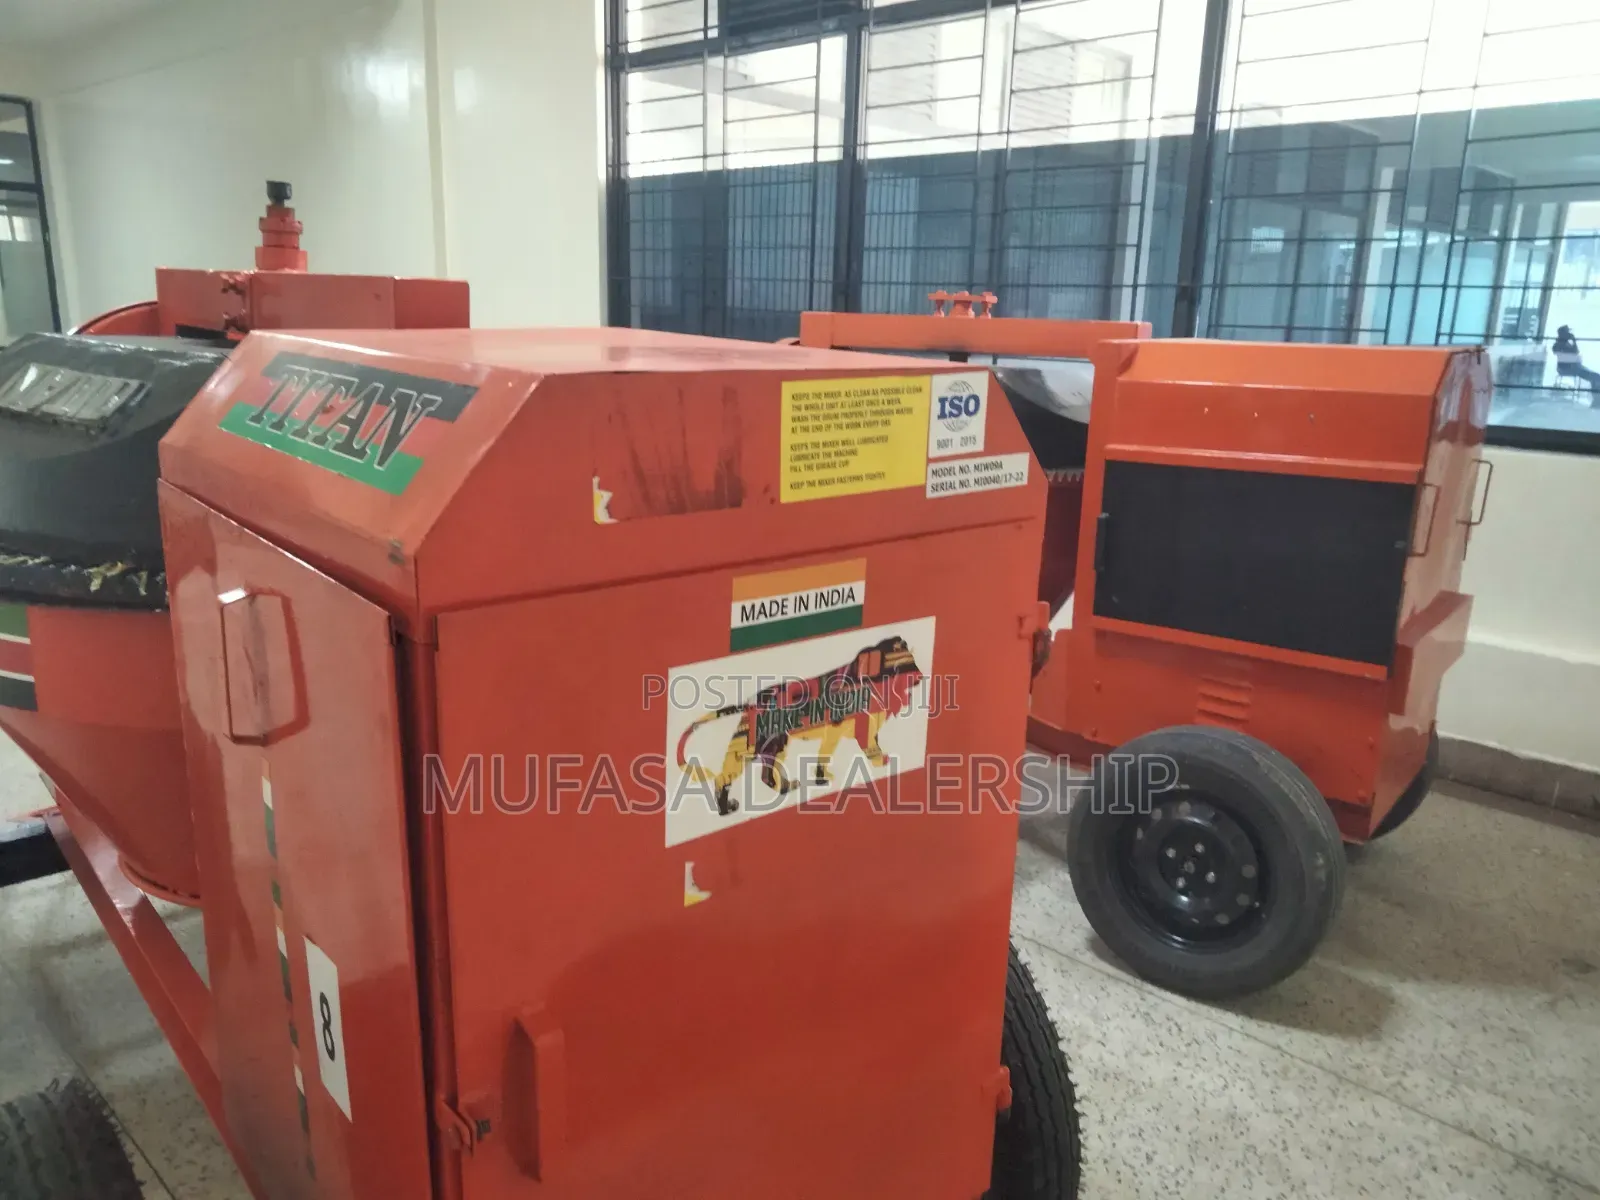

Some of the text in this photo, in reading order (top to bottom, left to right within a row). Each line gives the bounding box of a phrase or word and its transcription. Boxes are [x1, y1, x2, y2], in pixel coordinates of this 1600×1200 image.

[812, 391, 822, 400] THE
[824, 390, 841, 400] MIXER
[845, 389, 851, 398] AS
[853, 388, 871, 398] CLEAN
[872, 388, 879, 396] AS
[880, 386, 905, 395] POSSIBLE
[792, 403, 802, 412] THE
[804, 402, 824, 411] WHOLE
[825, 401, 839, 410] UNIT
[841, 400, 847, 409] AT
[848, 399, 865, 408] LEAST
[866, 398, 880, 407] ONCE
[937, 394, 981, 420] ISO
[246, 364, 443, 471] TITAN
[791, 414, 809, 423] WASH
[811, 413, 821, 422] THE
[791, 425, 798, 434] AT
[800, 424, 810, 433] THE
[811, 424, 823, 433] END
[825, 423, 832, 432] OF
[833, 422, 844, 431] THE
[845, 421, 861, 430] WORK
[863, 420, 879, 429] EVERY
[810, 441, 820, 450] THE
[822, 440, 840, 449] MIXER
[841, 438, 855, 447] WELL
[936, 439, 953, 450] 9001
[790, 448, 858, 462] LUBRICATE THE MACHINE
[804, 463, 815, 472] THE
[816, 461, 837, 471] GREASE
[838, 460, 849, 469] CUP
[931, 465, 957, 478] MODEL
[959, 463, 972, 474] NO.
[790, 481, 805, 490] KEEP
[806, 479, 816, 488] THE
[818, 477, 836, 487] MIXER
[930, 480, 957, 493] SERIAL
[959, 478, 972, 489] NO.
[740, 586, 856, 623] MADE IN INDIA
[756, 685, 870, 740] MAKE IN INDIA
[319, 991, 336, 1062] 8
